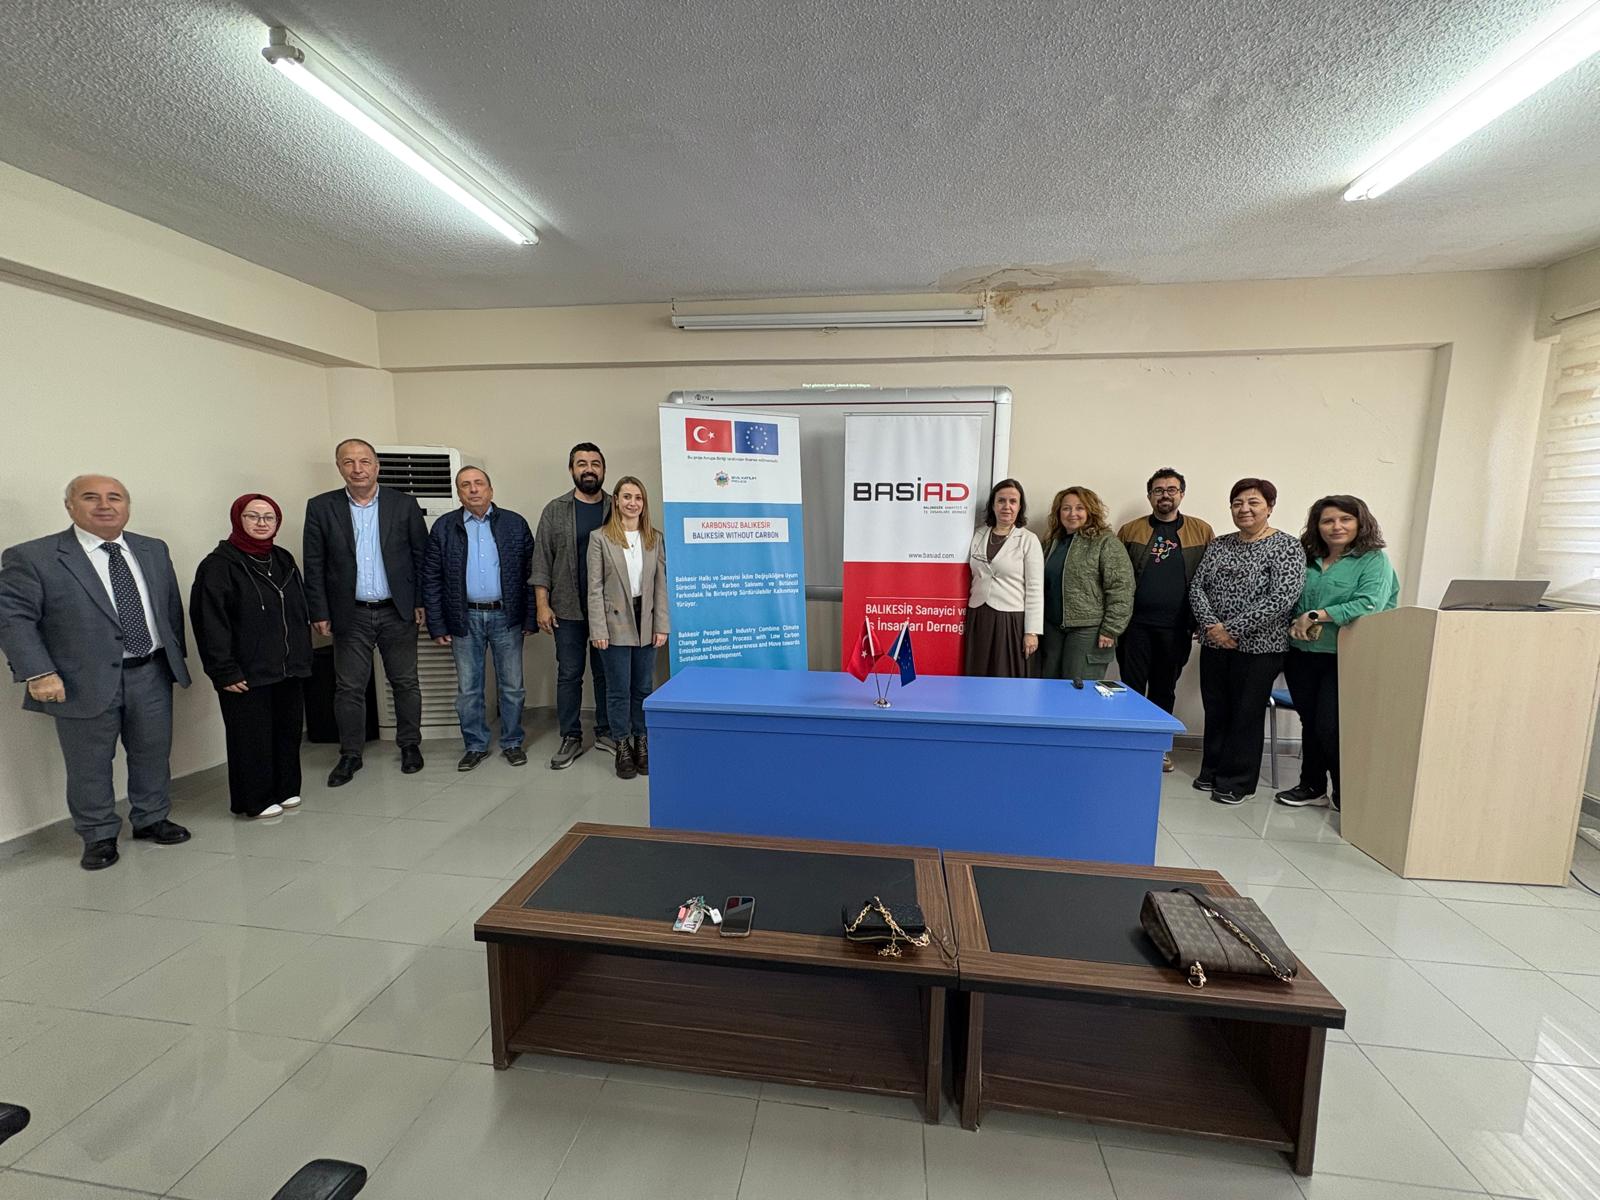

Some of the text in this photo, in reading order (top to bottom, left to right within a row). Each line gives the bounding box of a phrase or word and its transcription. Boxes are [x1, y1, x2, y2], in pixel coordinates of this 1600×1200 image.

[692, 531, 724, 540] BALIKESİR
[865, 602, 912, 614] BALIKESİR
[916, 605, 955, 617] Sanayici
